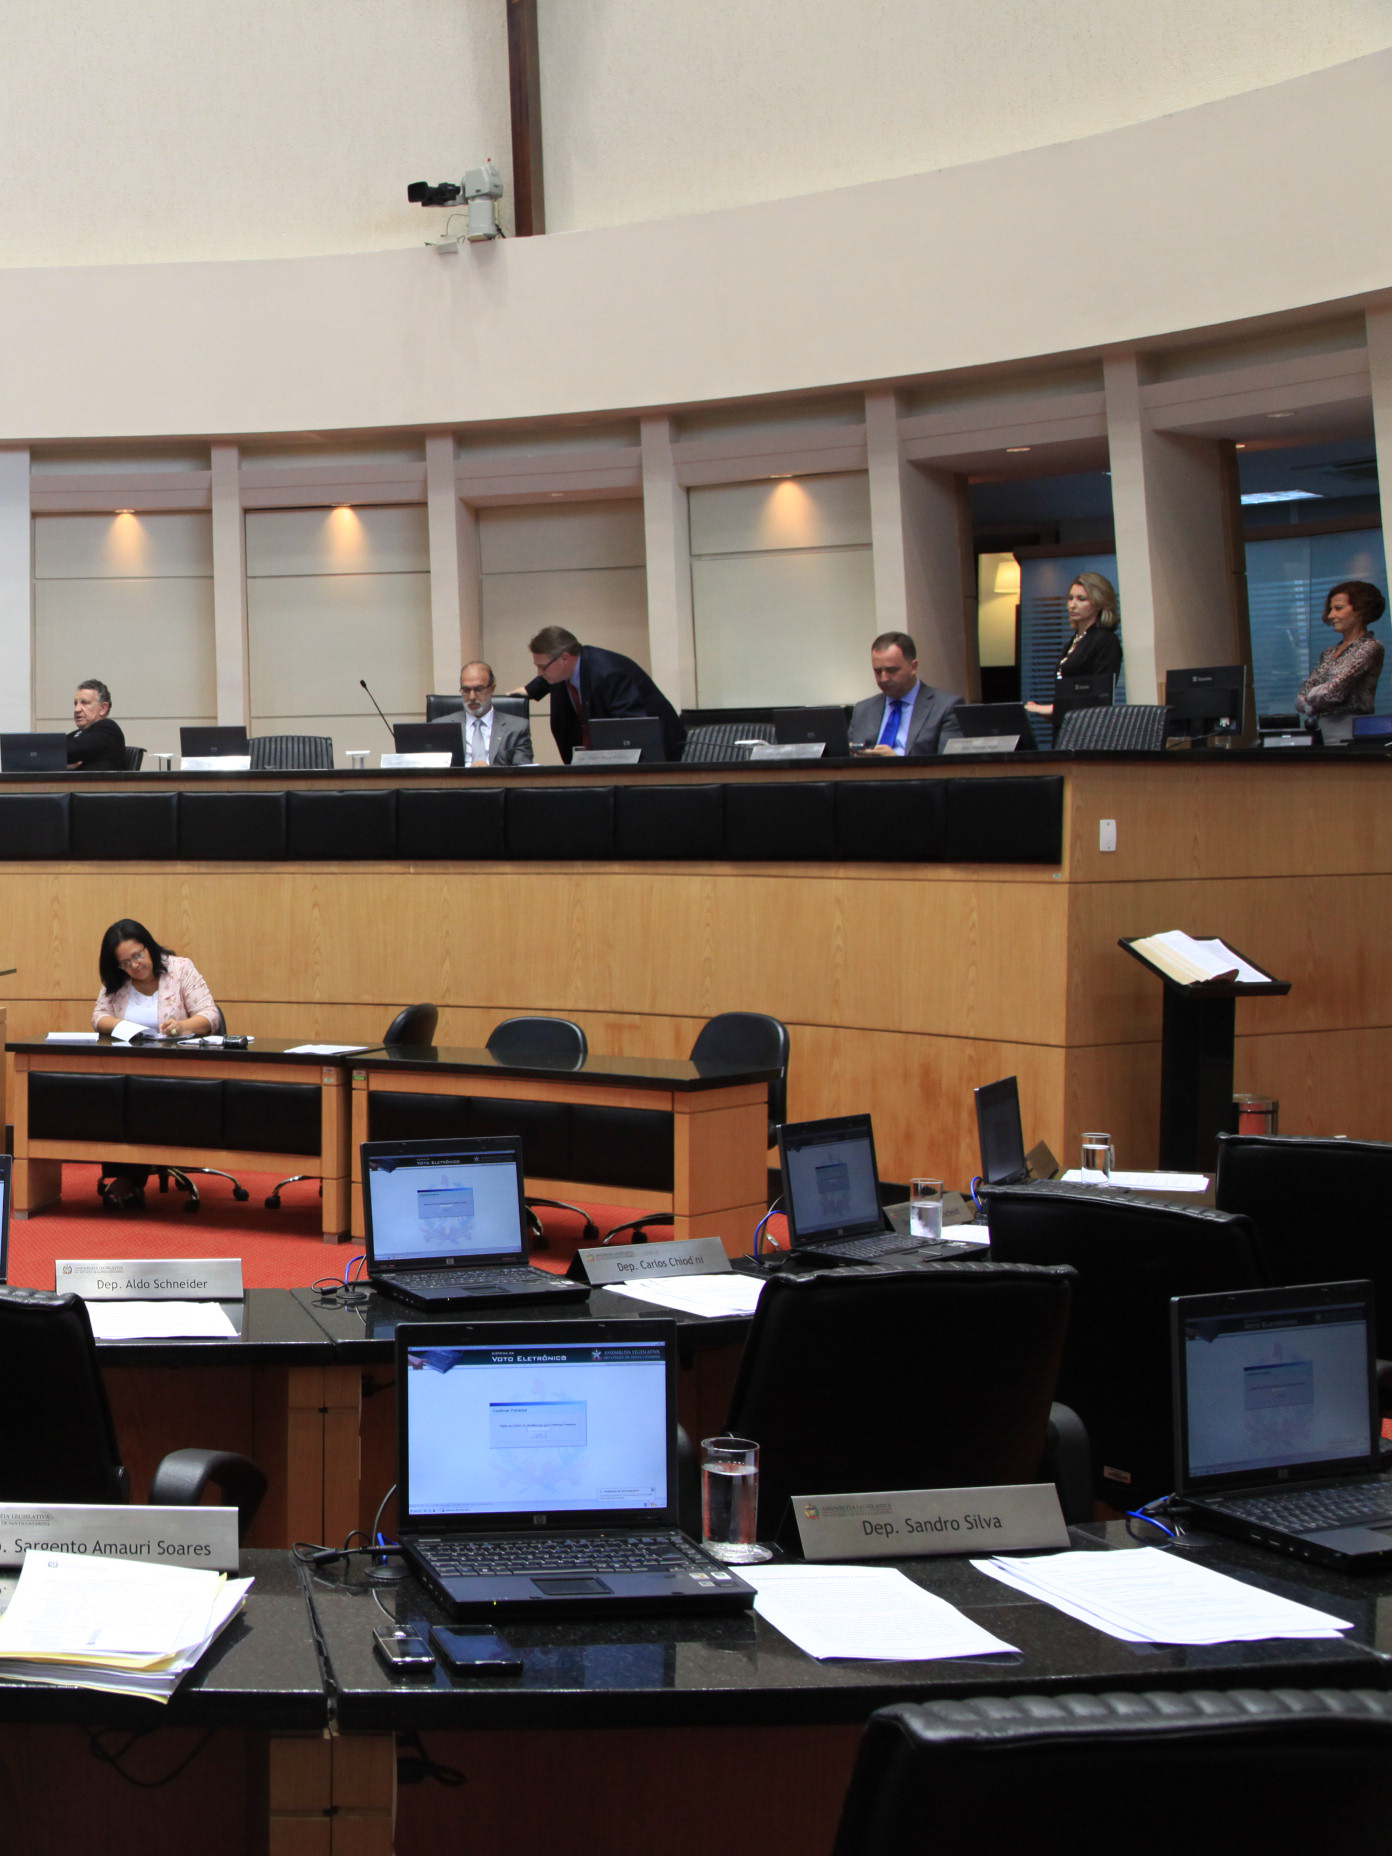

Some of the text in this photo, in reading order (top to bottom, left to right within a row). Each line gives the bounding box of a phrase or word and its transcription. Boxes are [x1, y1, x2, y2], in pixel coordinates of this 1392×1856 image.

[616, 1255, 704, 1273] Dep. Carlos Chiodni
[97, 1278, 208, 1291] Dep. Aldo Schneider
[862, 1514, 1003, 1538] Dep. Sandro Silva
[92, 1540, 151, 1555] Amauri
[157, 1540, 212, 1556] Soares
